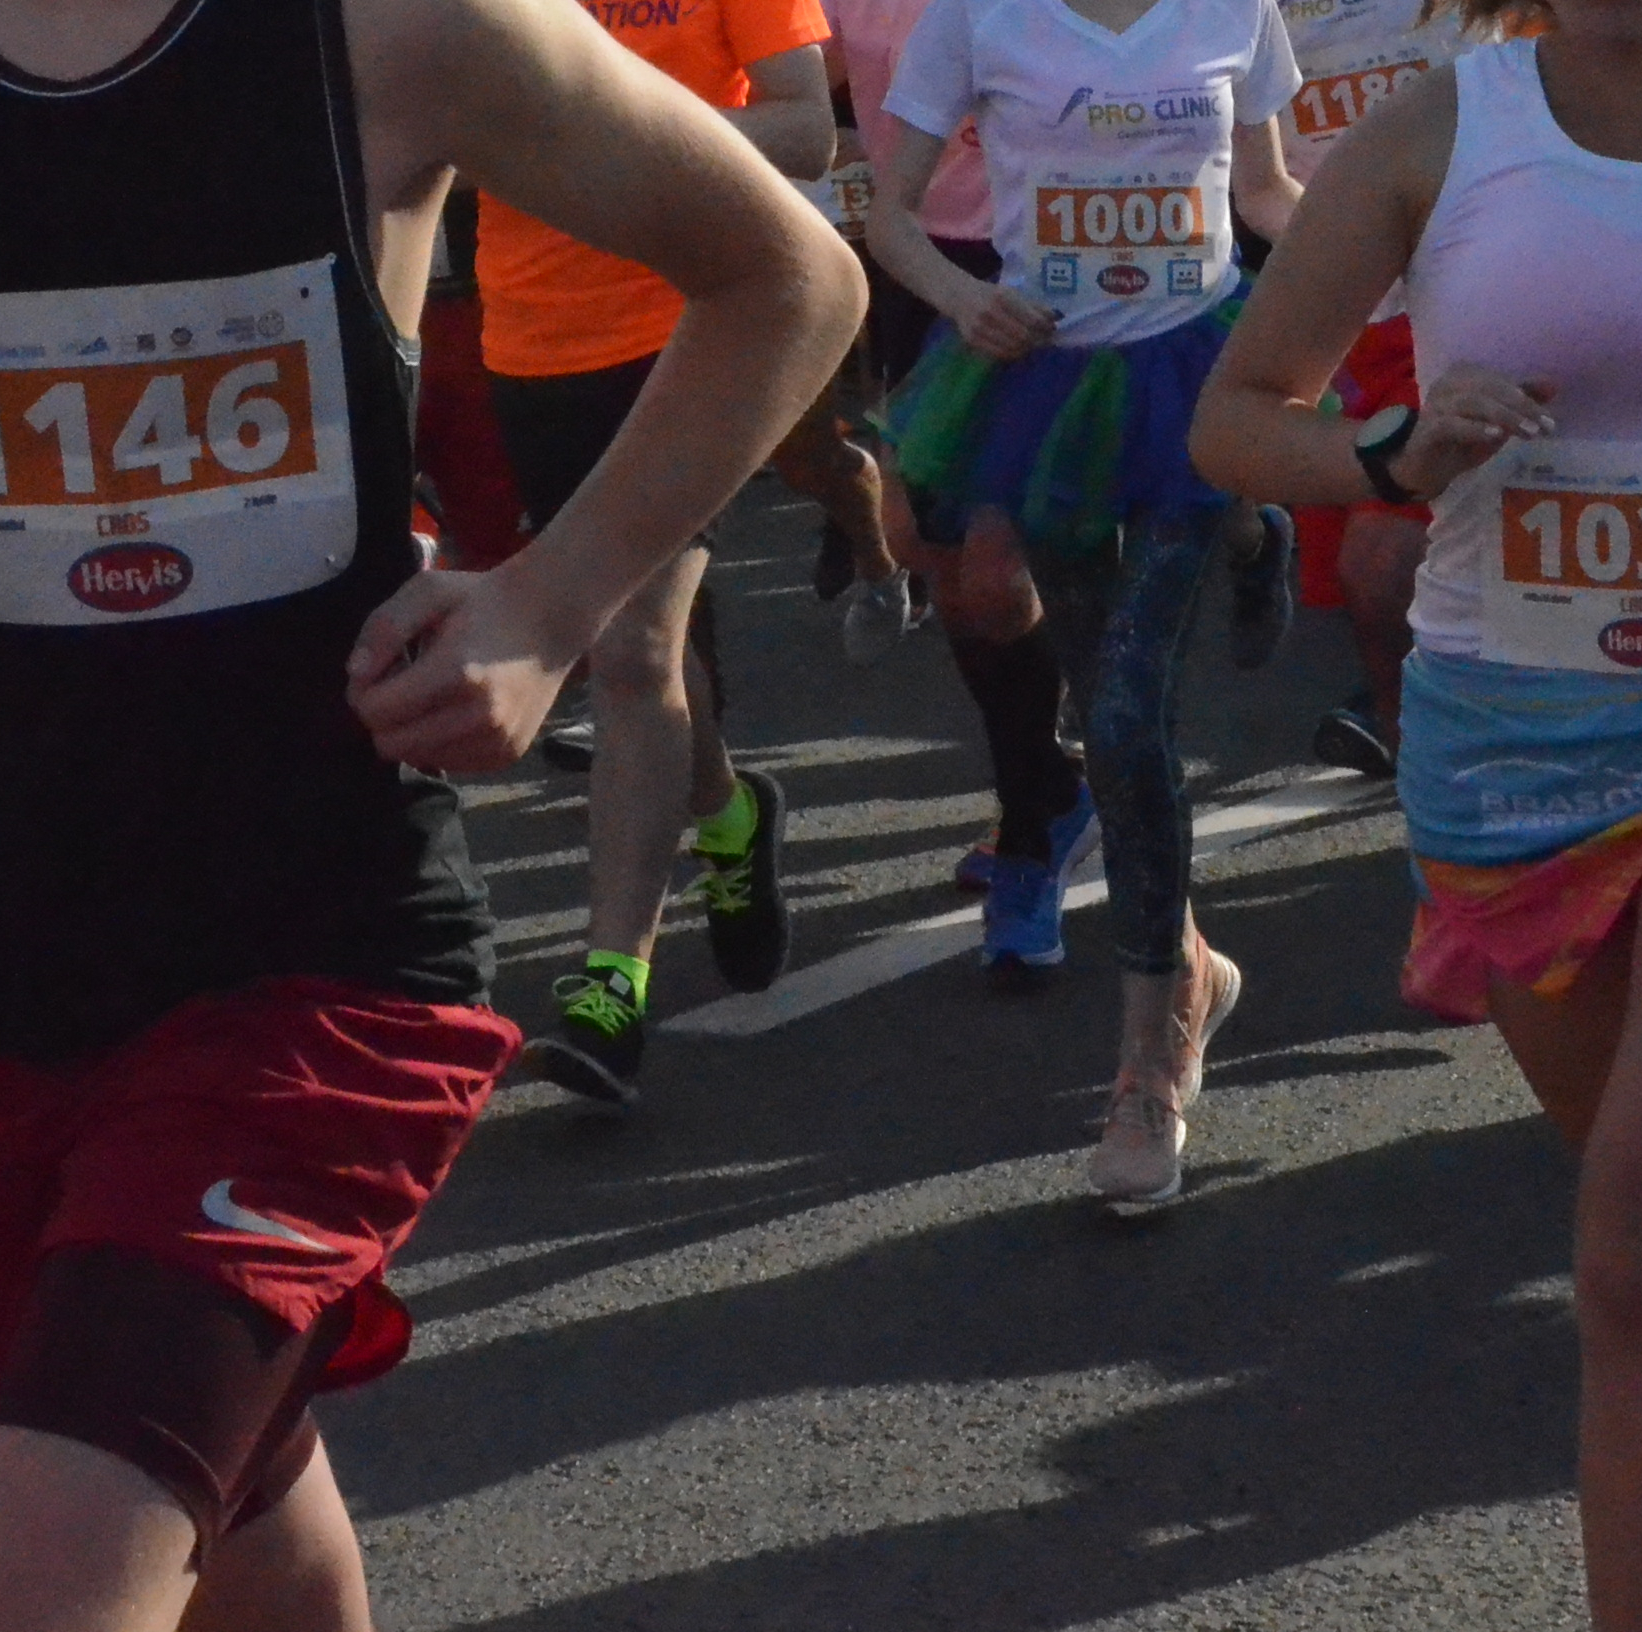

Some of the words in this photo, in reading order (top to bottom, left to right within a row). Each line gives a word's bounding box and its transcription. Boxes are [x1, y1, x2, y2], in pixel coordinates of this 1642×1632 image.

[1087, 102, 1146, 127] PRO
[1154, 95, 1221, 121] CLINIC
[1046, 191, 1195, 245] 1000
[79, 558, 184, 597] Hervis
